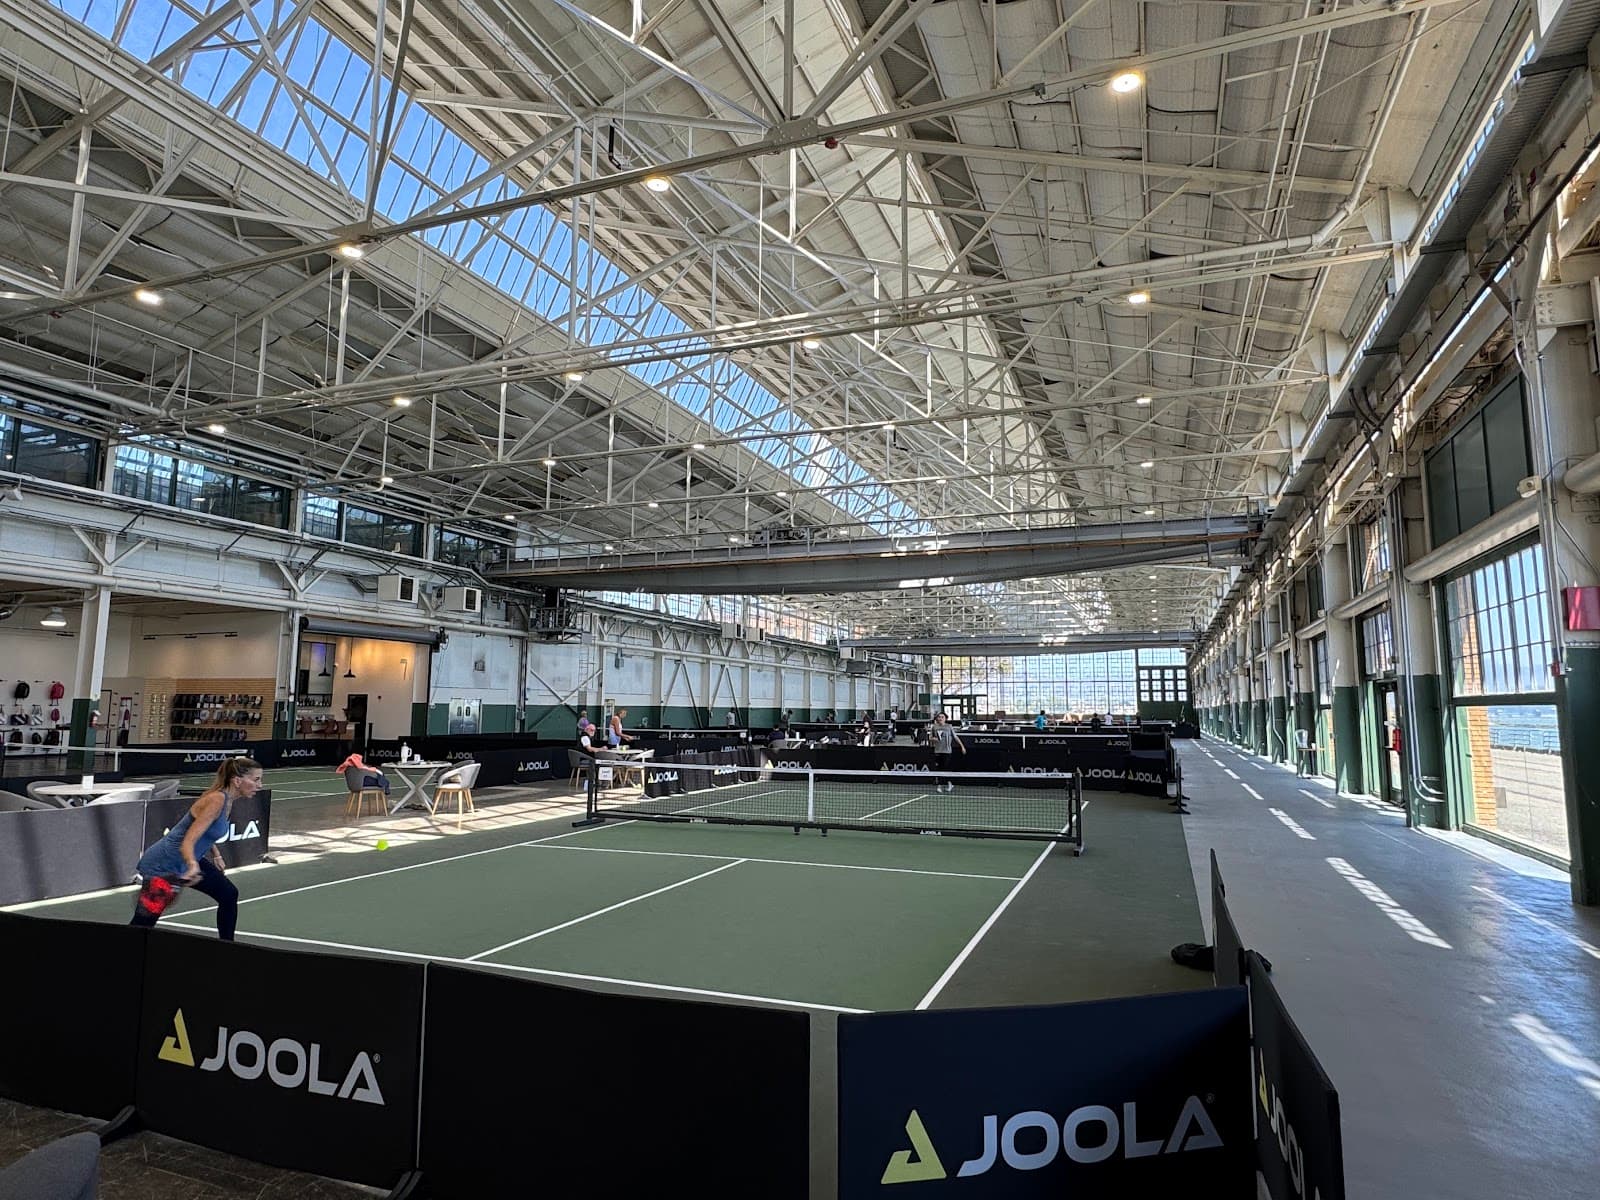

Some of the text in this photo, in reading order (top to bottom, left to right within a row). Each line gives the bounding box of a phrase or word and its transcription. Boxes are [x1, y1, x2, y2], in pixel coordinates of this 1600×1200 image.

[193, 753, 227, 762] JOOLA
[289, 749, 316, 757] JOOLA
[375, 750, 400, 758] JOOLA
[453, 752, 474, 760] JOOL
[524, 760, 550, 772] JOOLA
[775, 760, 812, 770] JOOLA
[890, 763, 930, 772] JOOLA
[654, 770, 678, 782] JOOLA
[1134, 771, 1163, 784] JOOLA
[200, 1026, 386, 1105] JOOLA
[955, 1094, 1225, 1178] JOOLA
